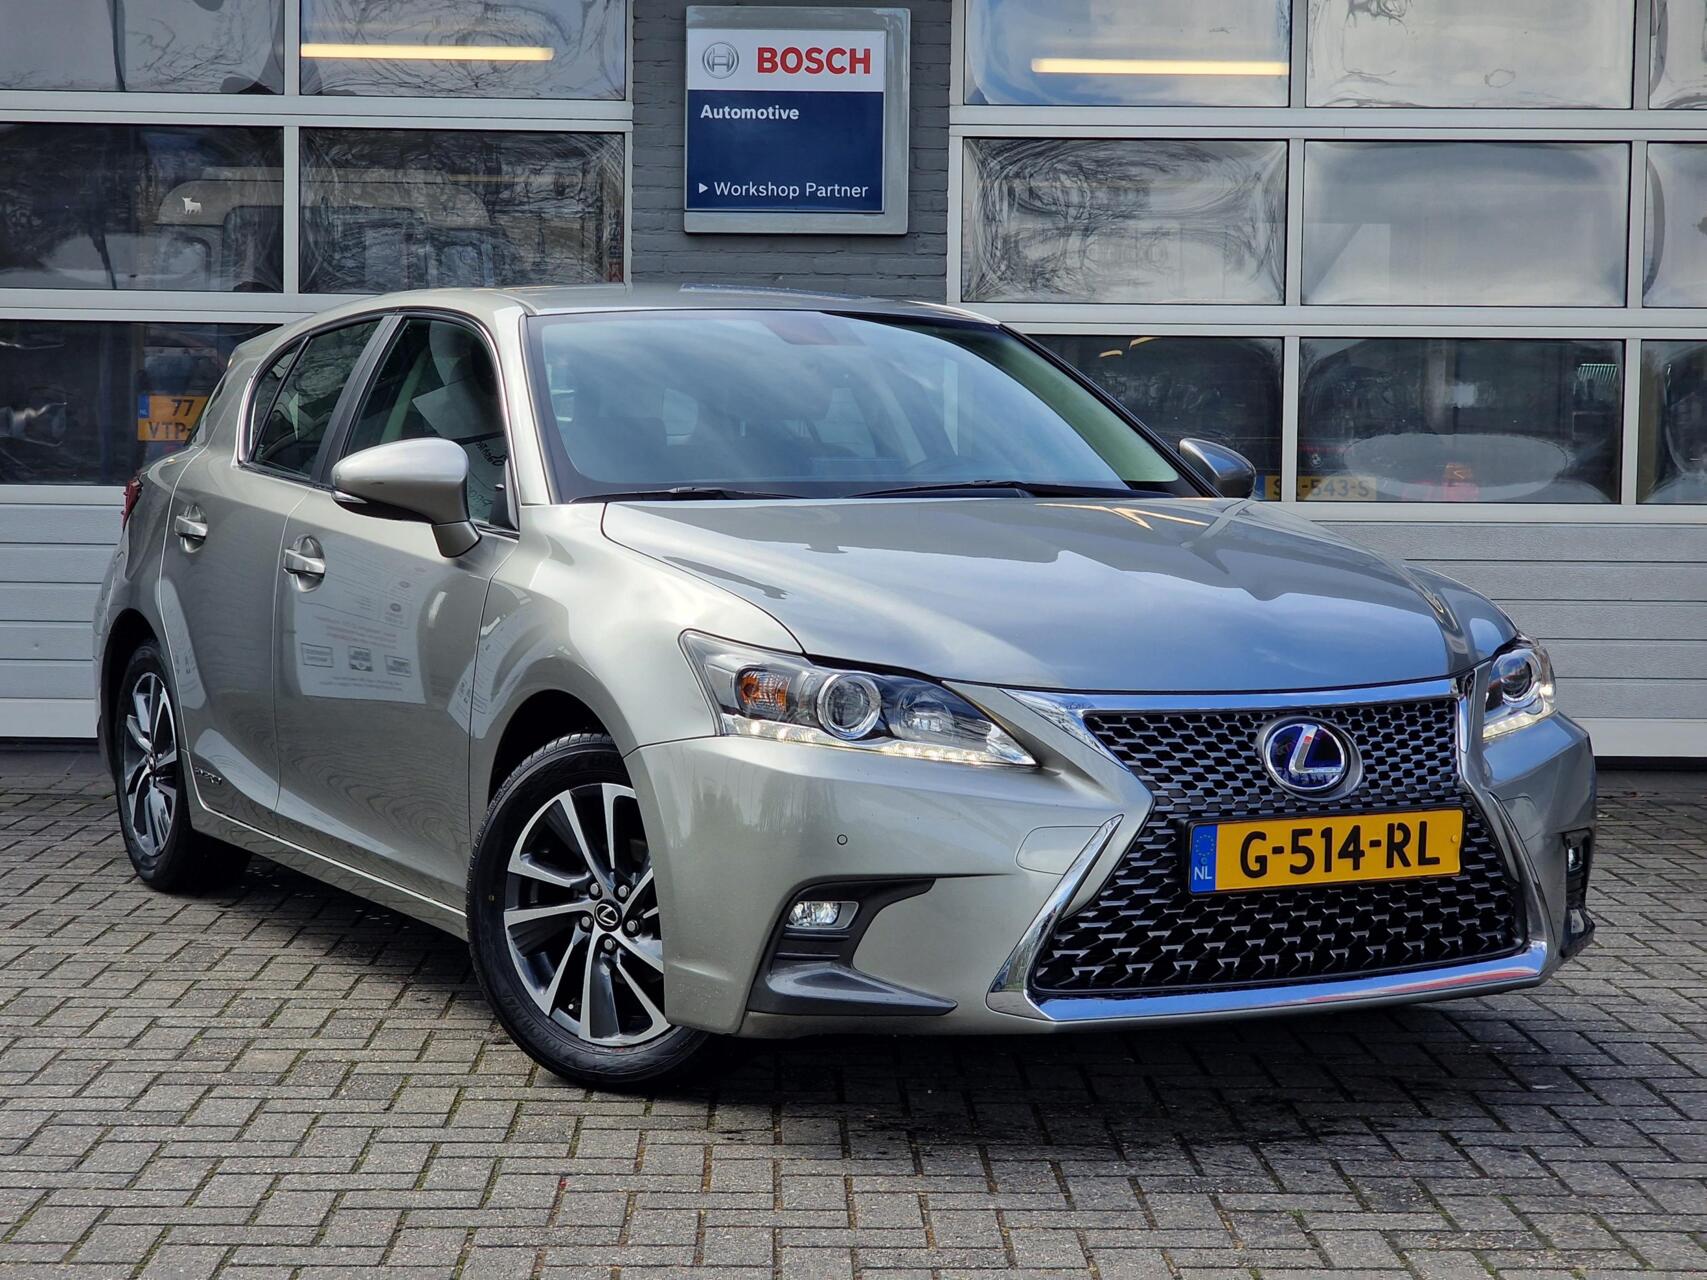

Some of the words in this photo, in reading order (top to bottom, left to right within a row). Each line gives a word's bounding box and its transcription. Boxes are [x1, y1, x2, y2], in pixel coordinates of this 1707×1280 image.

[757, 47, 871, 75] BOSCH
[700, 104, 800, 120] Automotive
[714, 181, 800, 200] Workshop
[805, 182, 869, 198] Partner
[171, 399, 194, 416] 77
[1273, 476, 1370, 498] S-543-S
[1239, 820, 1441, 879] G-514-RL
[1194, 866, 1212, 880] NL
